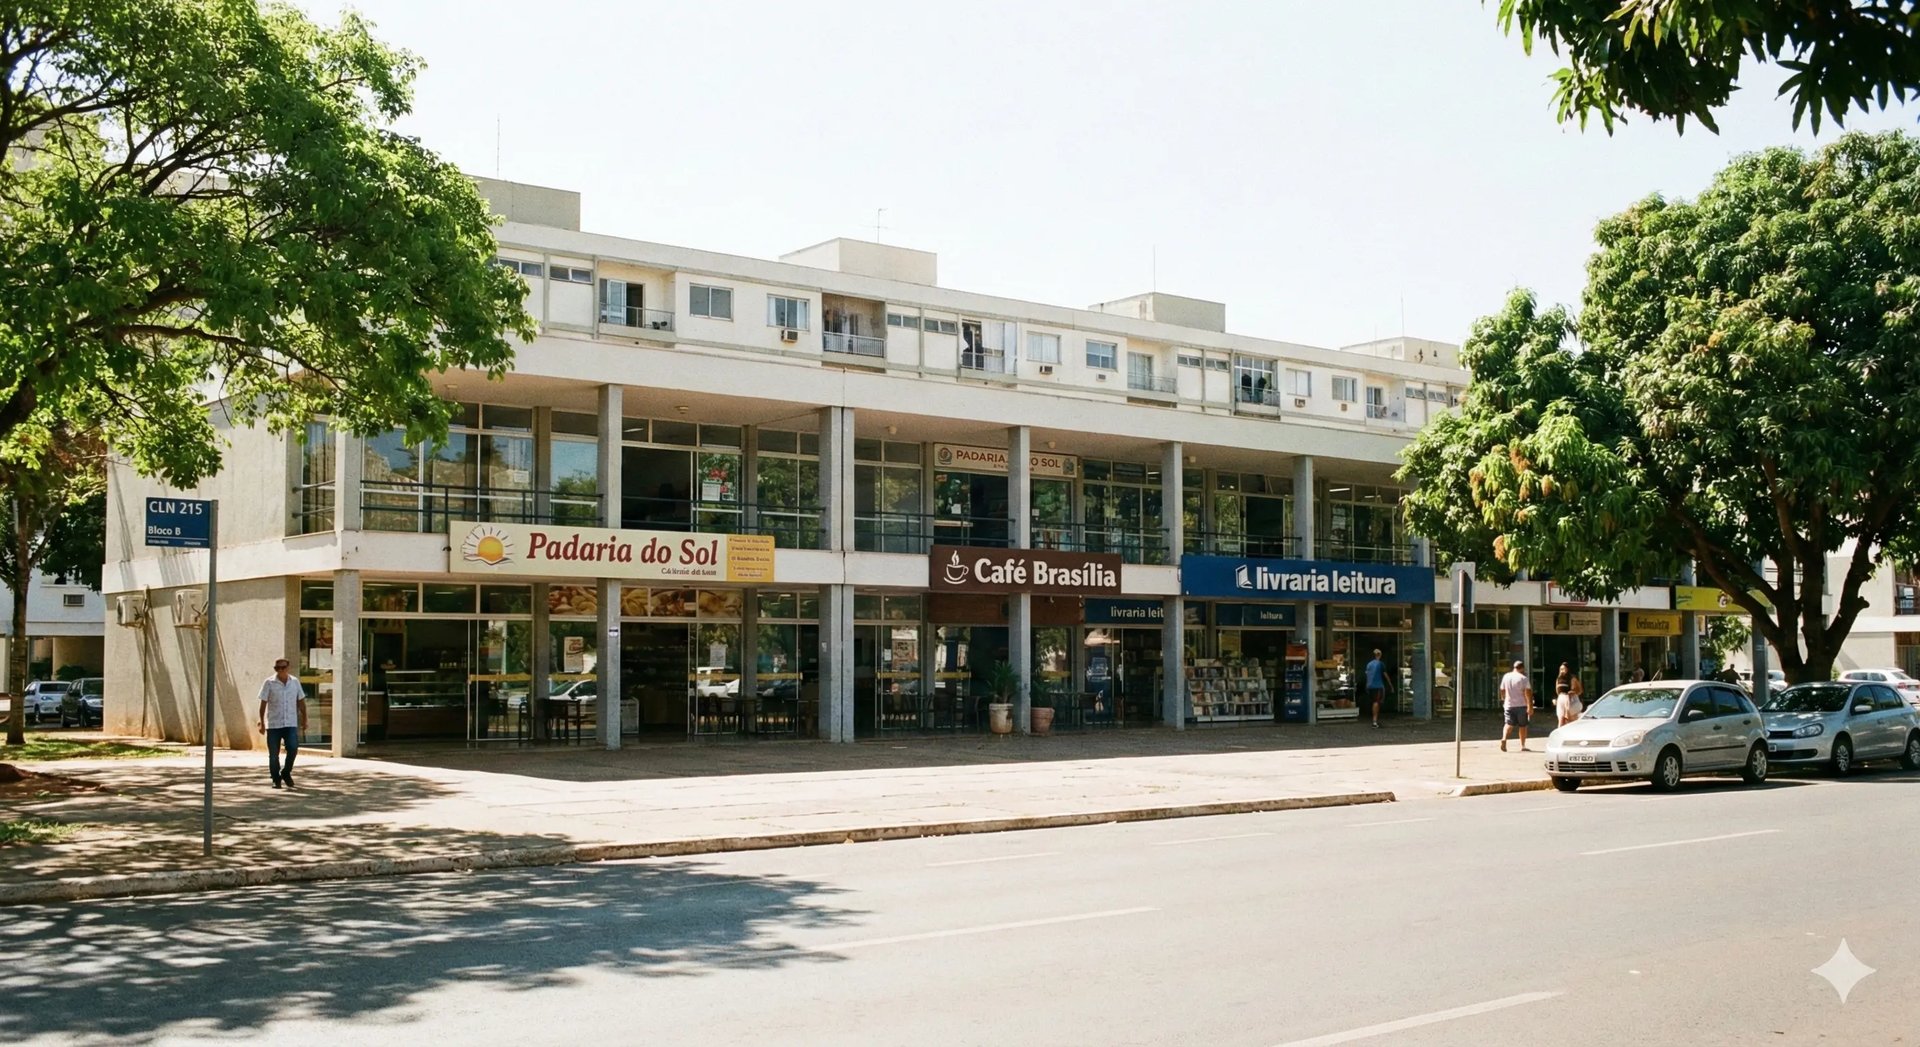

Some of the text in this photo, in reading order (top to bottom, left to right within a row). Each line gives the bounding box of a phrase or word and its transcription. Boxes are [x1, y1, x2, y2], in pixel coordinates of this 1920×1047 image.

[956, 449, 1004, 463] PADARIA
[1041, 458, 1061, 468] SOL
[149, 501, 202, 515] CLN 215
[148, 525, 181, 536] Bloco B
[526, 532, 719, 566] Padaria do Sol
[974, 557, 1117, 587] Café Brasília
[1256, 566, 1397, 595] livraria leitura
[1110, 606, 1165, 618] livraria leit
